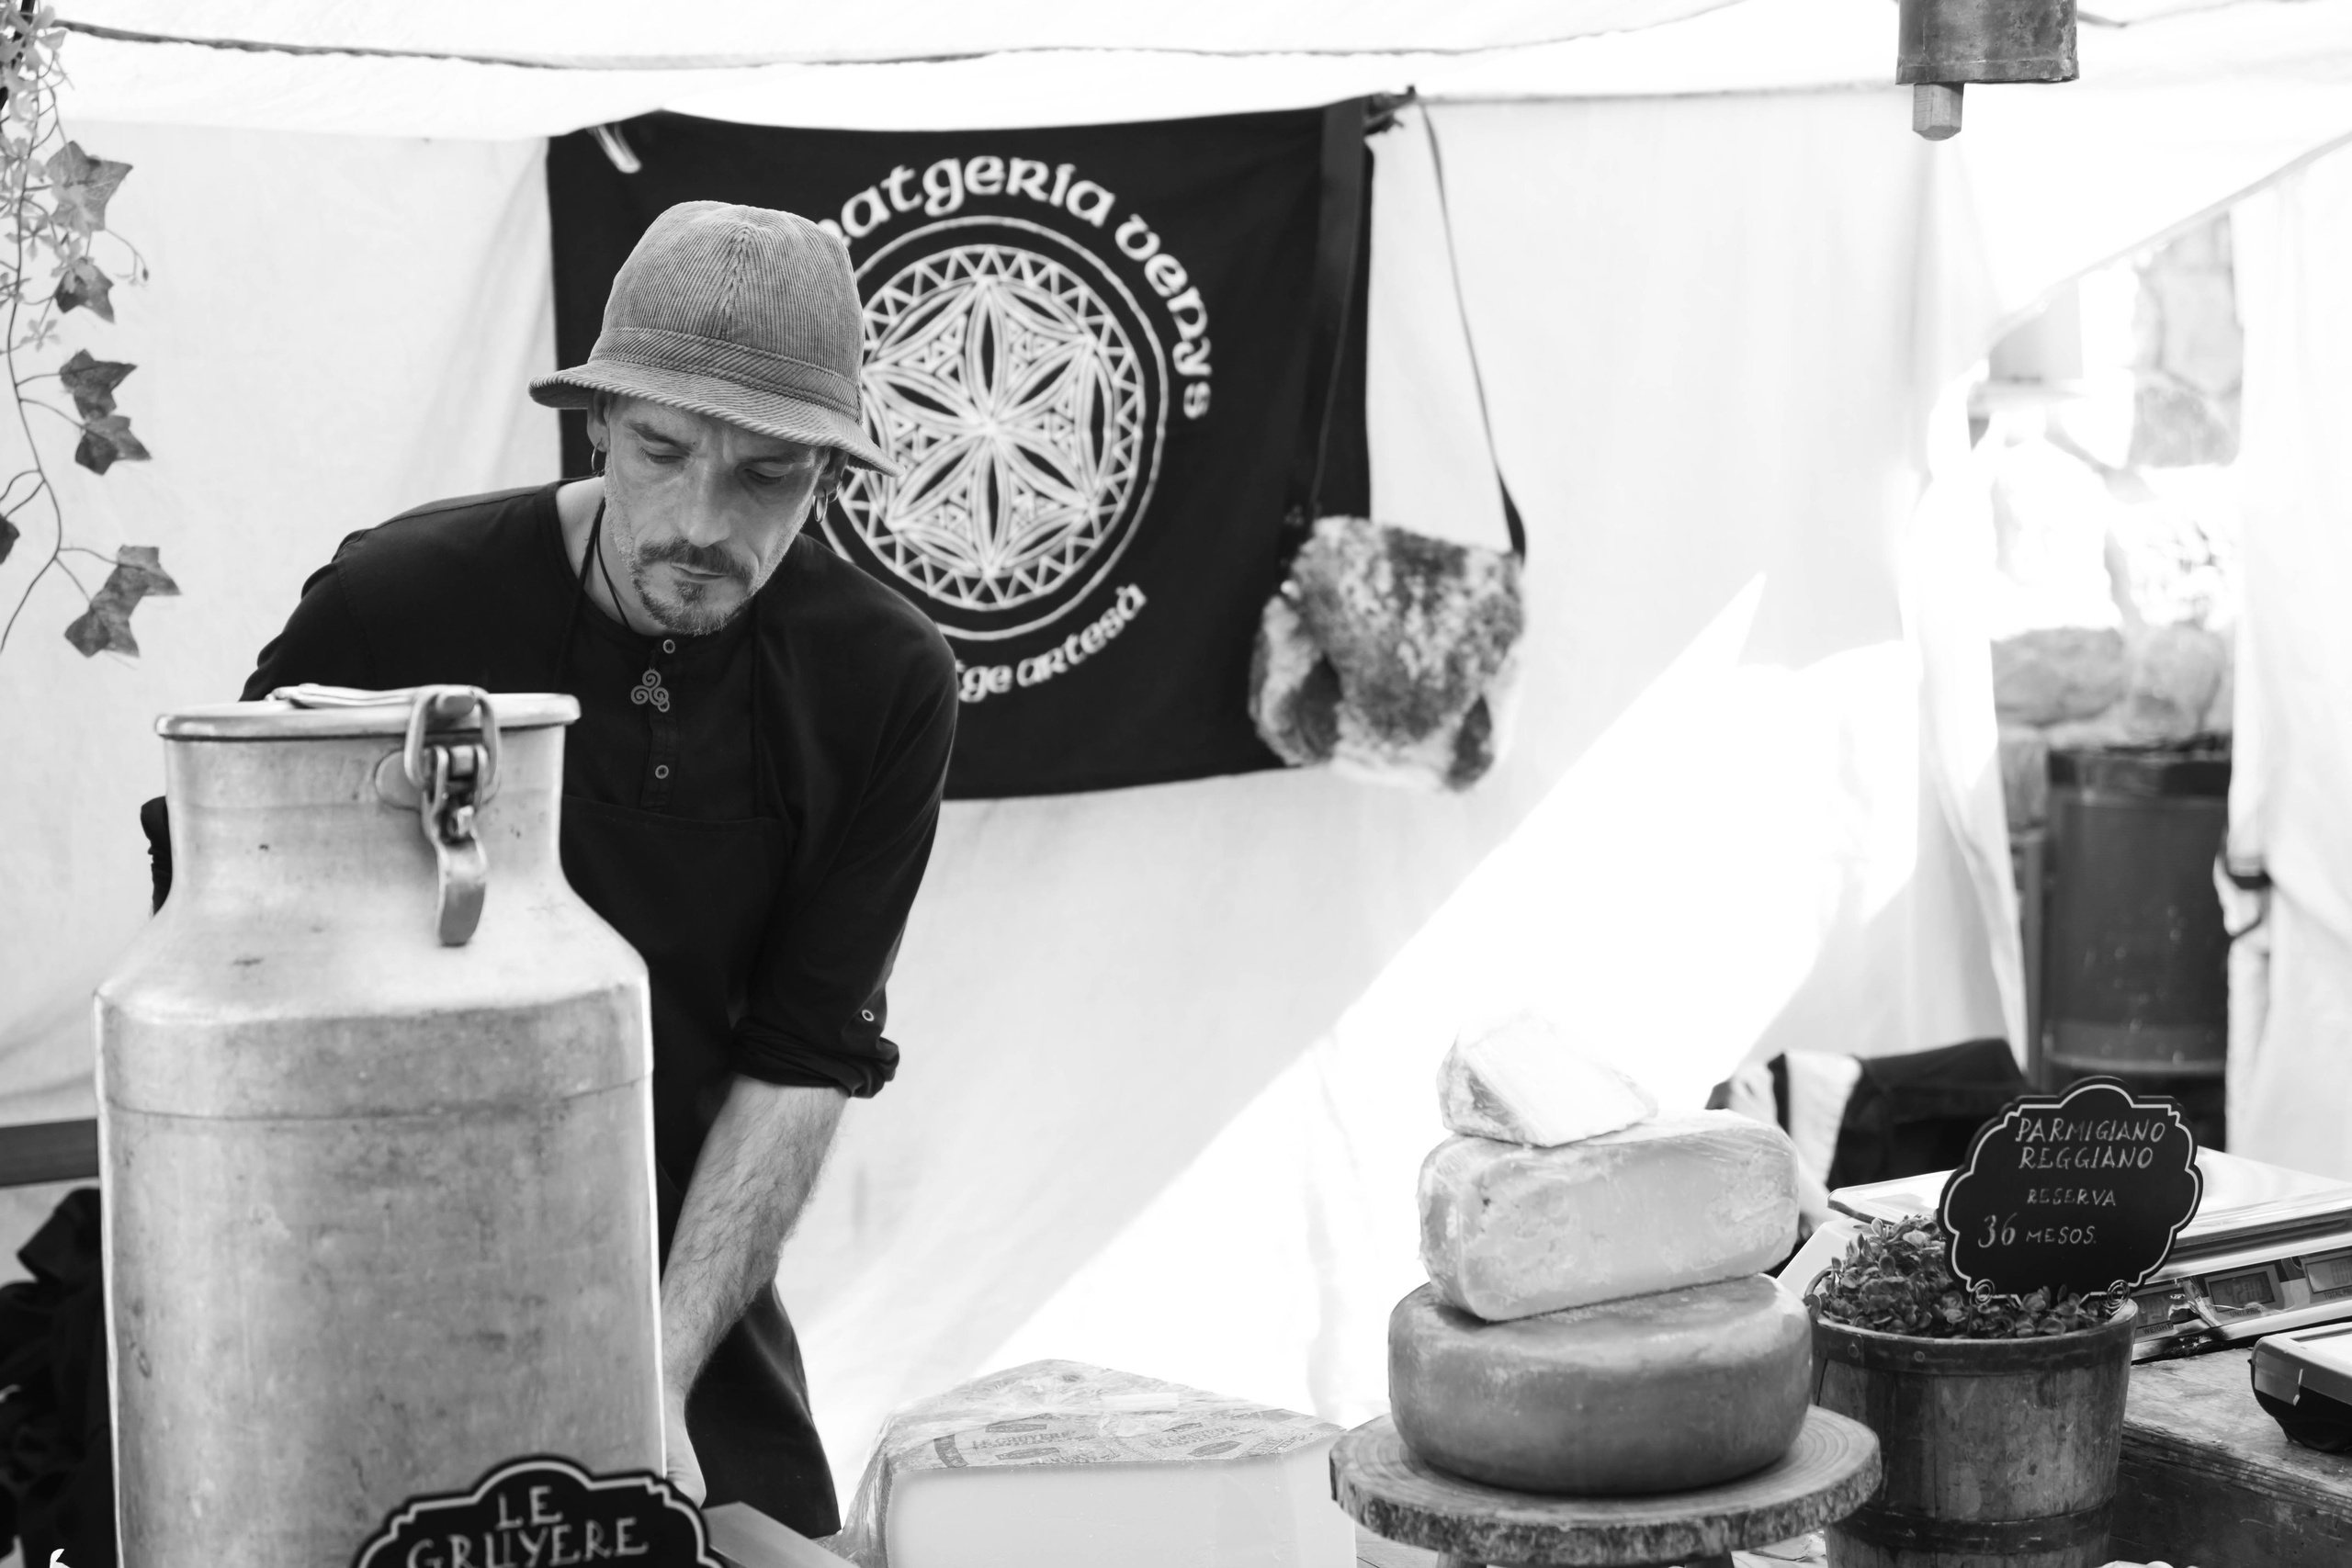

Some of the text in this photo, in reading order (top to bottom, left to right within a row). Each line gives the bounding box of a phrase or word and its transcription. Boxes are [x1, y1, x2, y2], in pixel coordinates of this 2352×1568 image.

[2015, 1117, 2165, 1143] PARMIGIANO
[2018, 1145, 2154, 1169] REGGIANO
[2027, 1188, 2116, 1206] RESERVA
[1978, 1213, 2018, 1248] 36
[496, 1485, 563, 1530] LE
